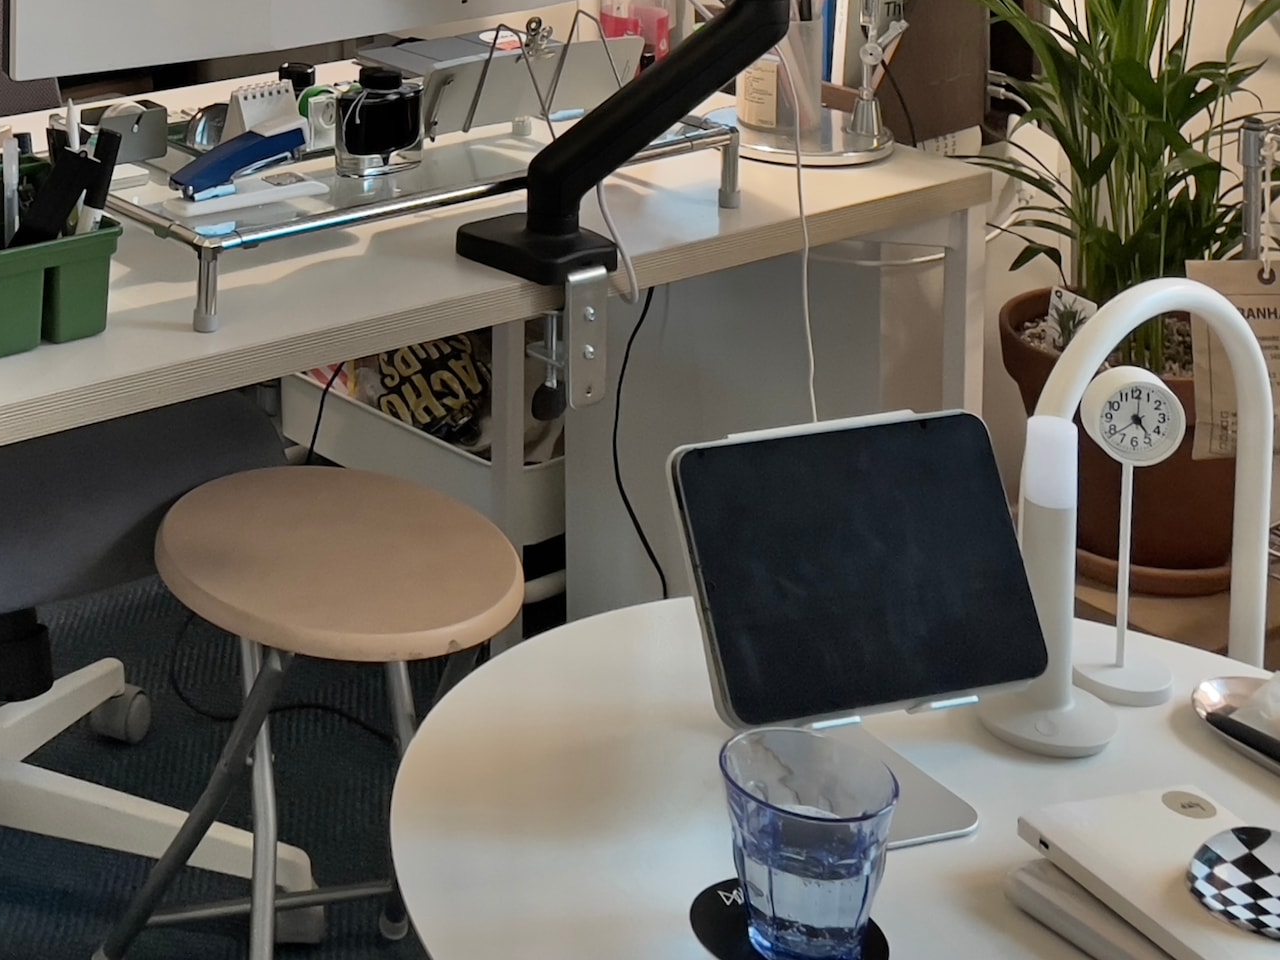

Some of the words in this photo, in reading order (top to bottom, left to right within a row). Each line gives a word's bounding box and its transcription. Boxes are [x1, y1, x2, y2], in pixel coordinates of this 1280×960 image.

[380, 353, 488, 426] ACHO
[1131, 387, 1142, 400] 12
[1120, 392, 1128, 402] 11
[1108, 401, 1120, 411] 10
[1154, 400, 1162, 410] 2
[1105, 412, 1113, 423] 9
[1157, 413, 1166, 423] 3
[1108, 424, 1116, 435] 8
[1153, 426, 1161, 435] 4
[1120, 433, 1126, 443] 7
[1130, 437, 1138, 447] 6
